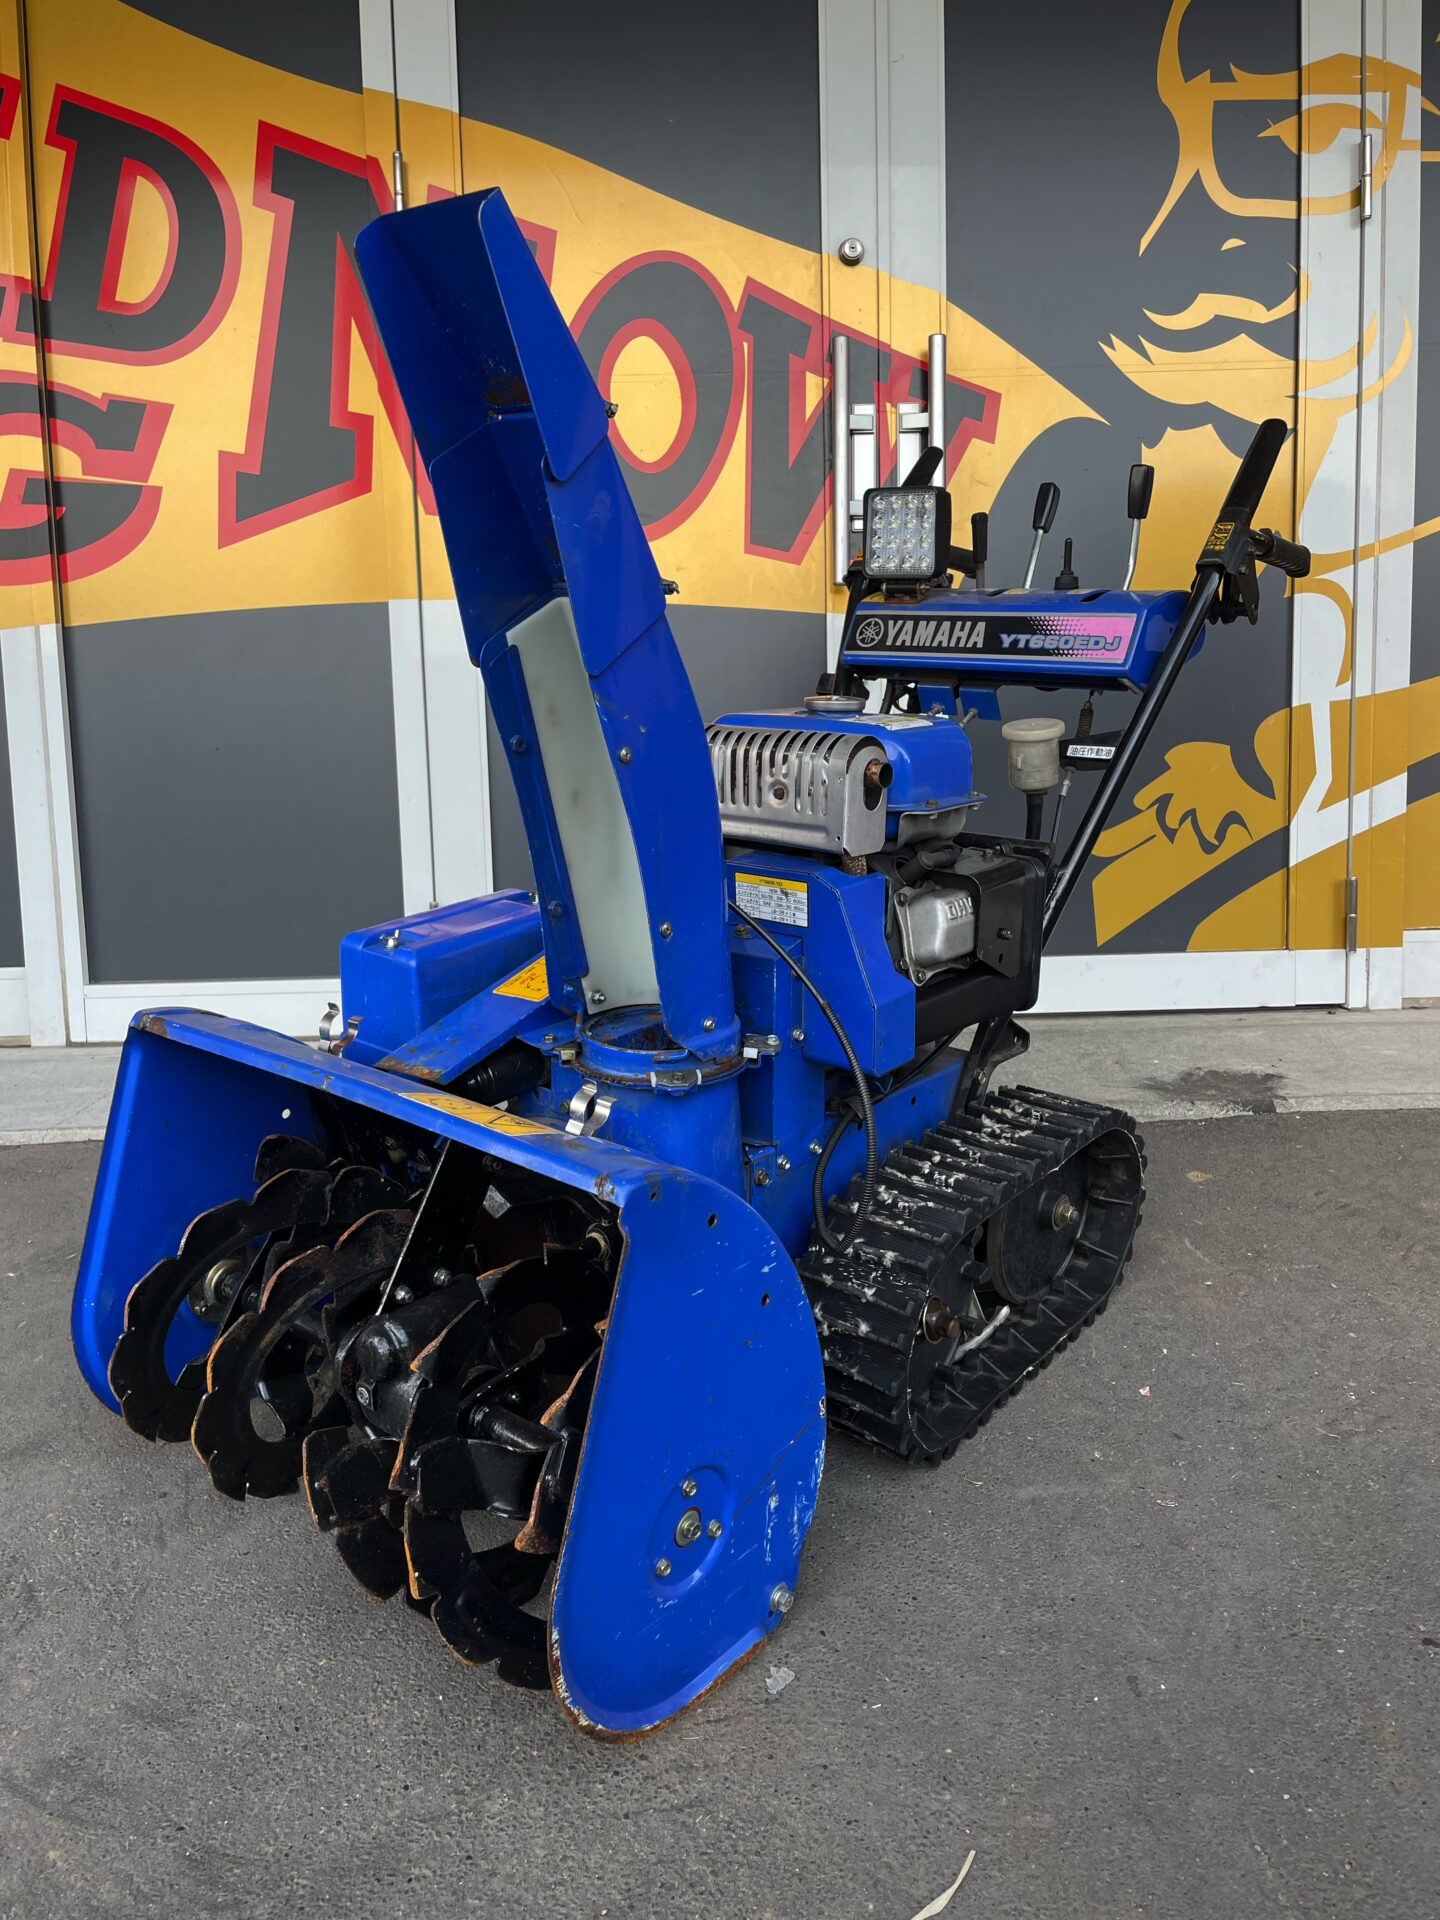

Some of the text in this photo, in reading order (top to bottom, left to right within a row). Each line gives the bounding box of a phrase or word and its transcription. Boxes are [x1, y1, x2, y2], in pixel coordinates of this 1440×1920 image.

[0, 73, 243, 367] D
[885, 619, 987, 649] YAMAHA
[998, 633, 1123, 652] YT660EDJ
[1069, 746, 1113, 758] 油圧作動油
[945, 896, 974, 921] OHV
